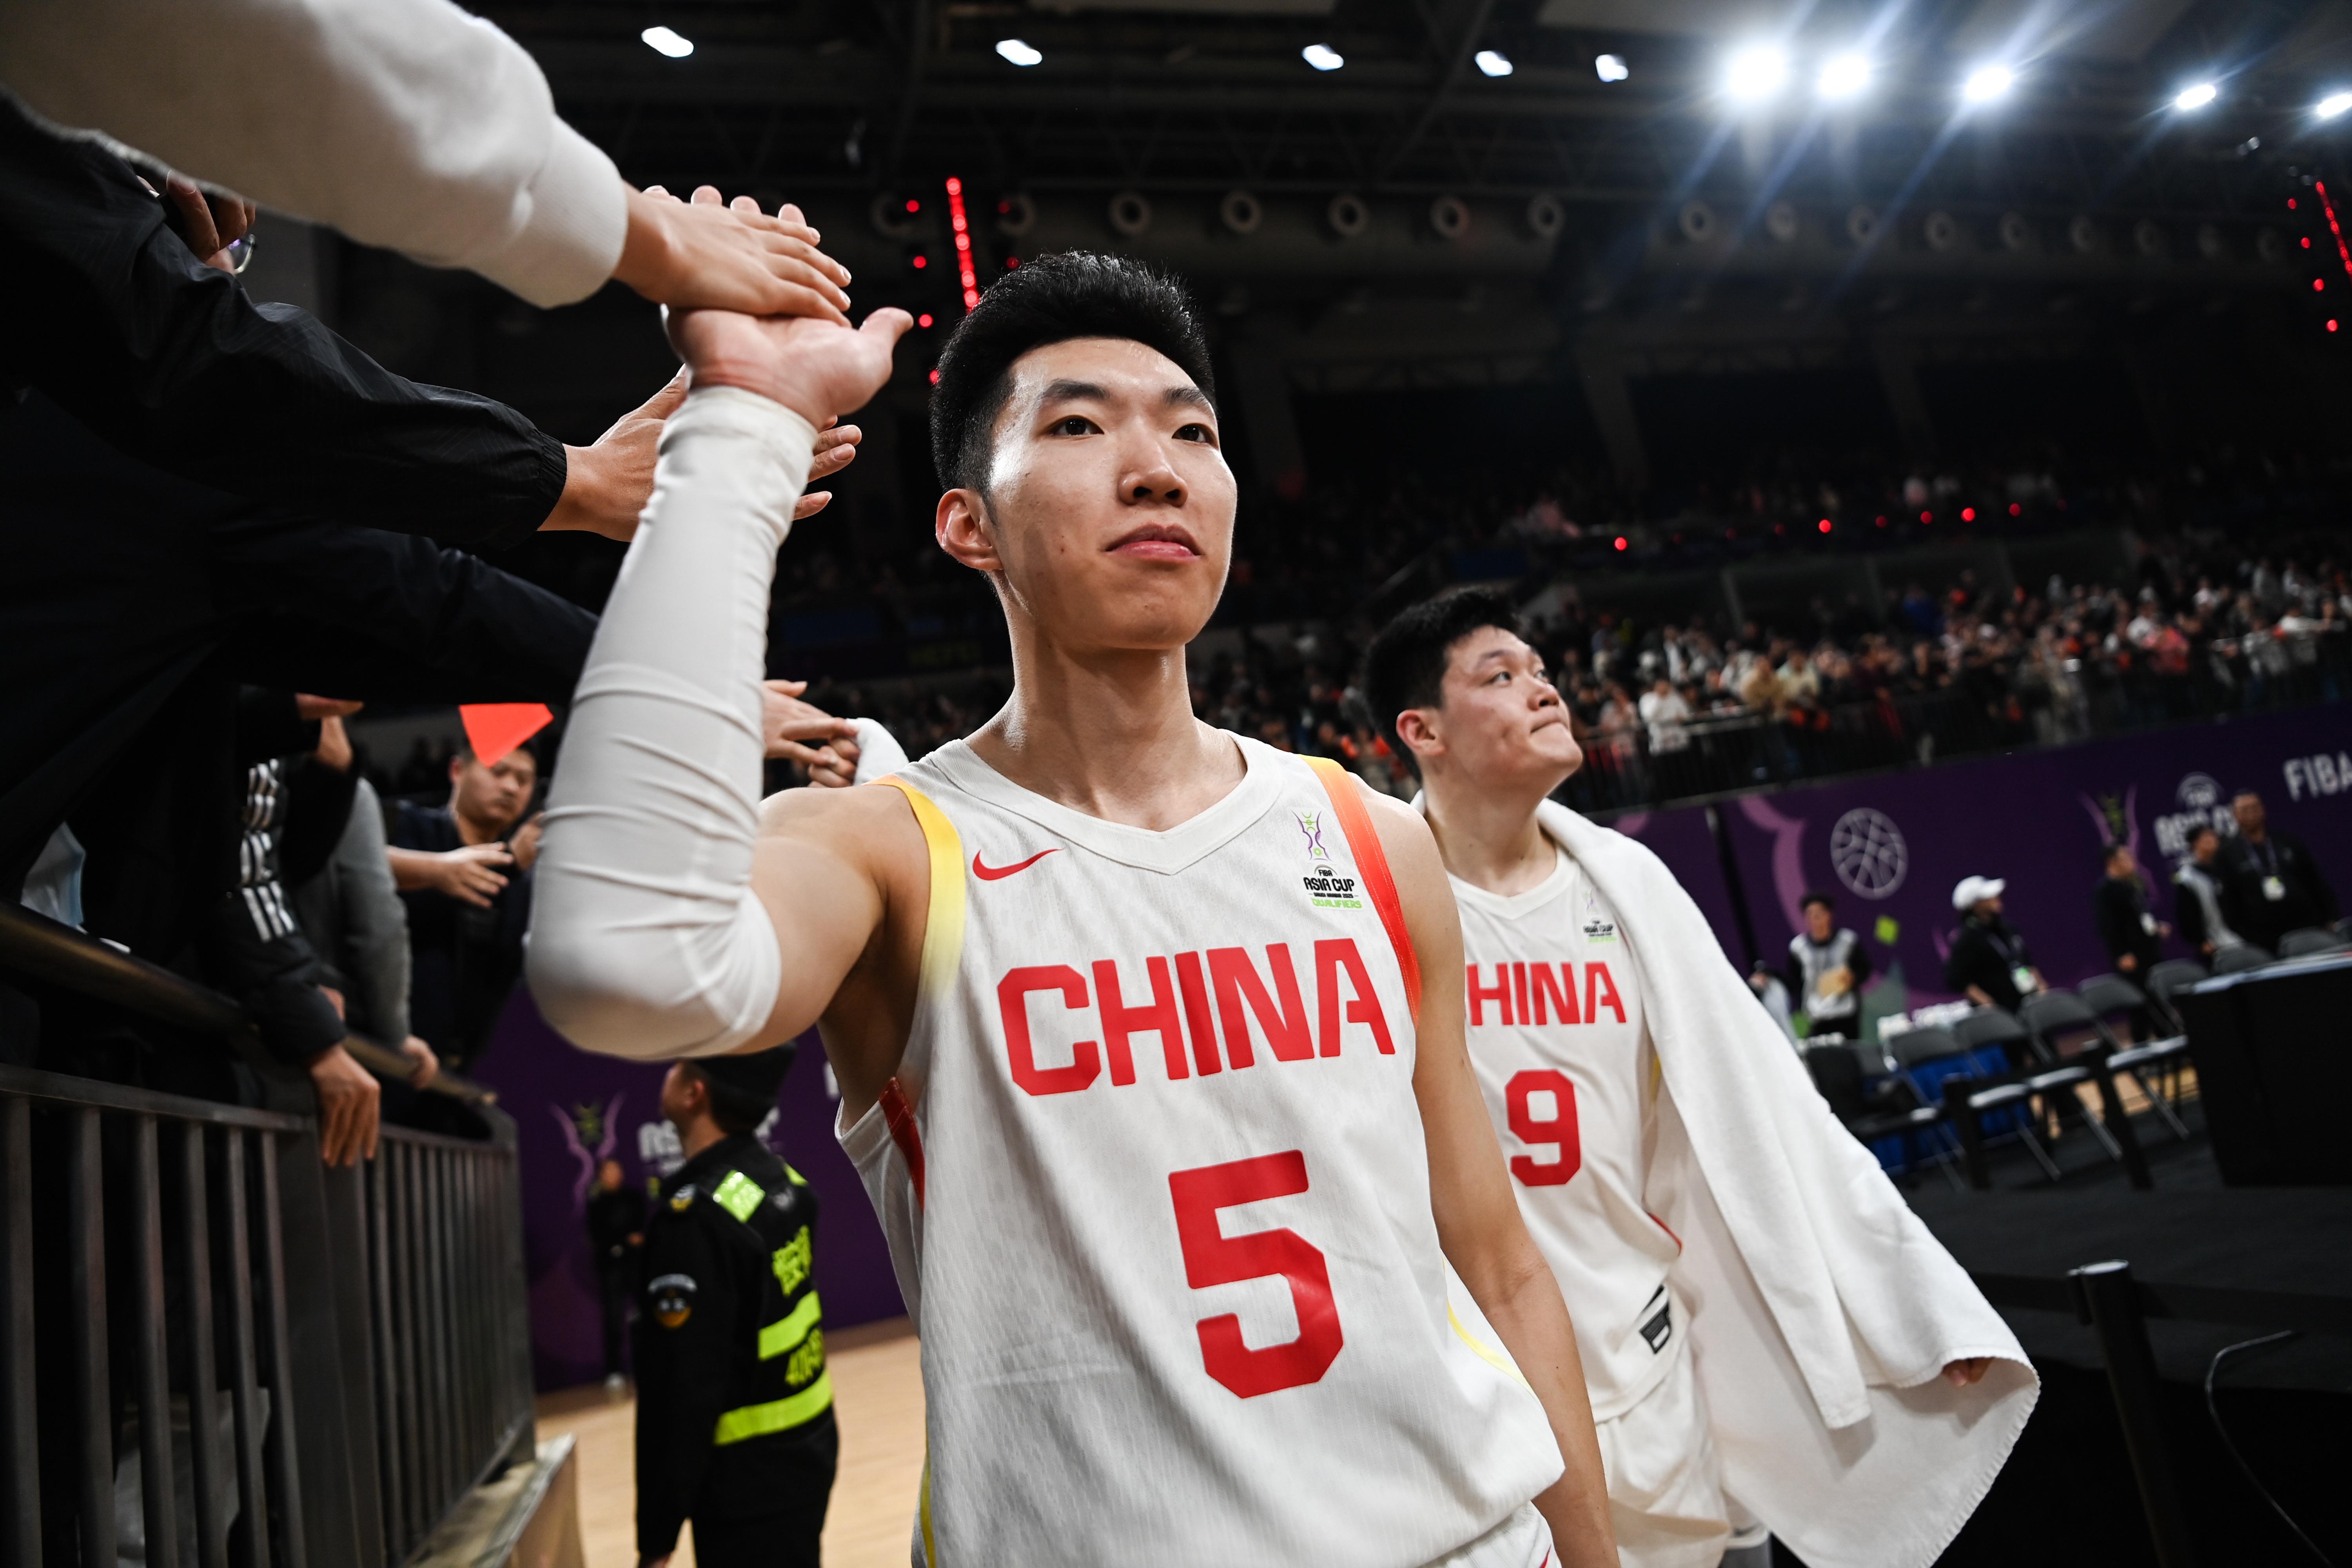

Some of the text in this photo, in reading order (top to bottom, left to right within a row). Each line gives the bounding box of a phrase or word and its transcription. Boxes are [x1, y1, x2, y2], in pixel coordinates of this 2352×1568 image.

[1303, 877, 1354, 892] ASIA CUP
[1310, 898, 1362, 909] QUALIFIERS
[997, 938, 1396, 1096] CHINA
[1466, 961, 1627, 1026] HINA
[1505, 1069, 1581, 1187] 9
[1169, 1149, 1344, 1399] 5
